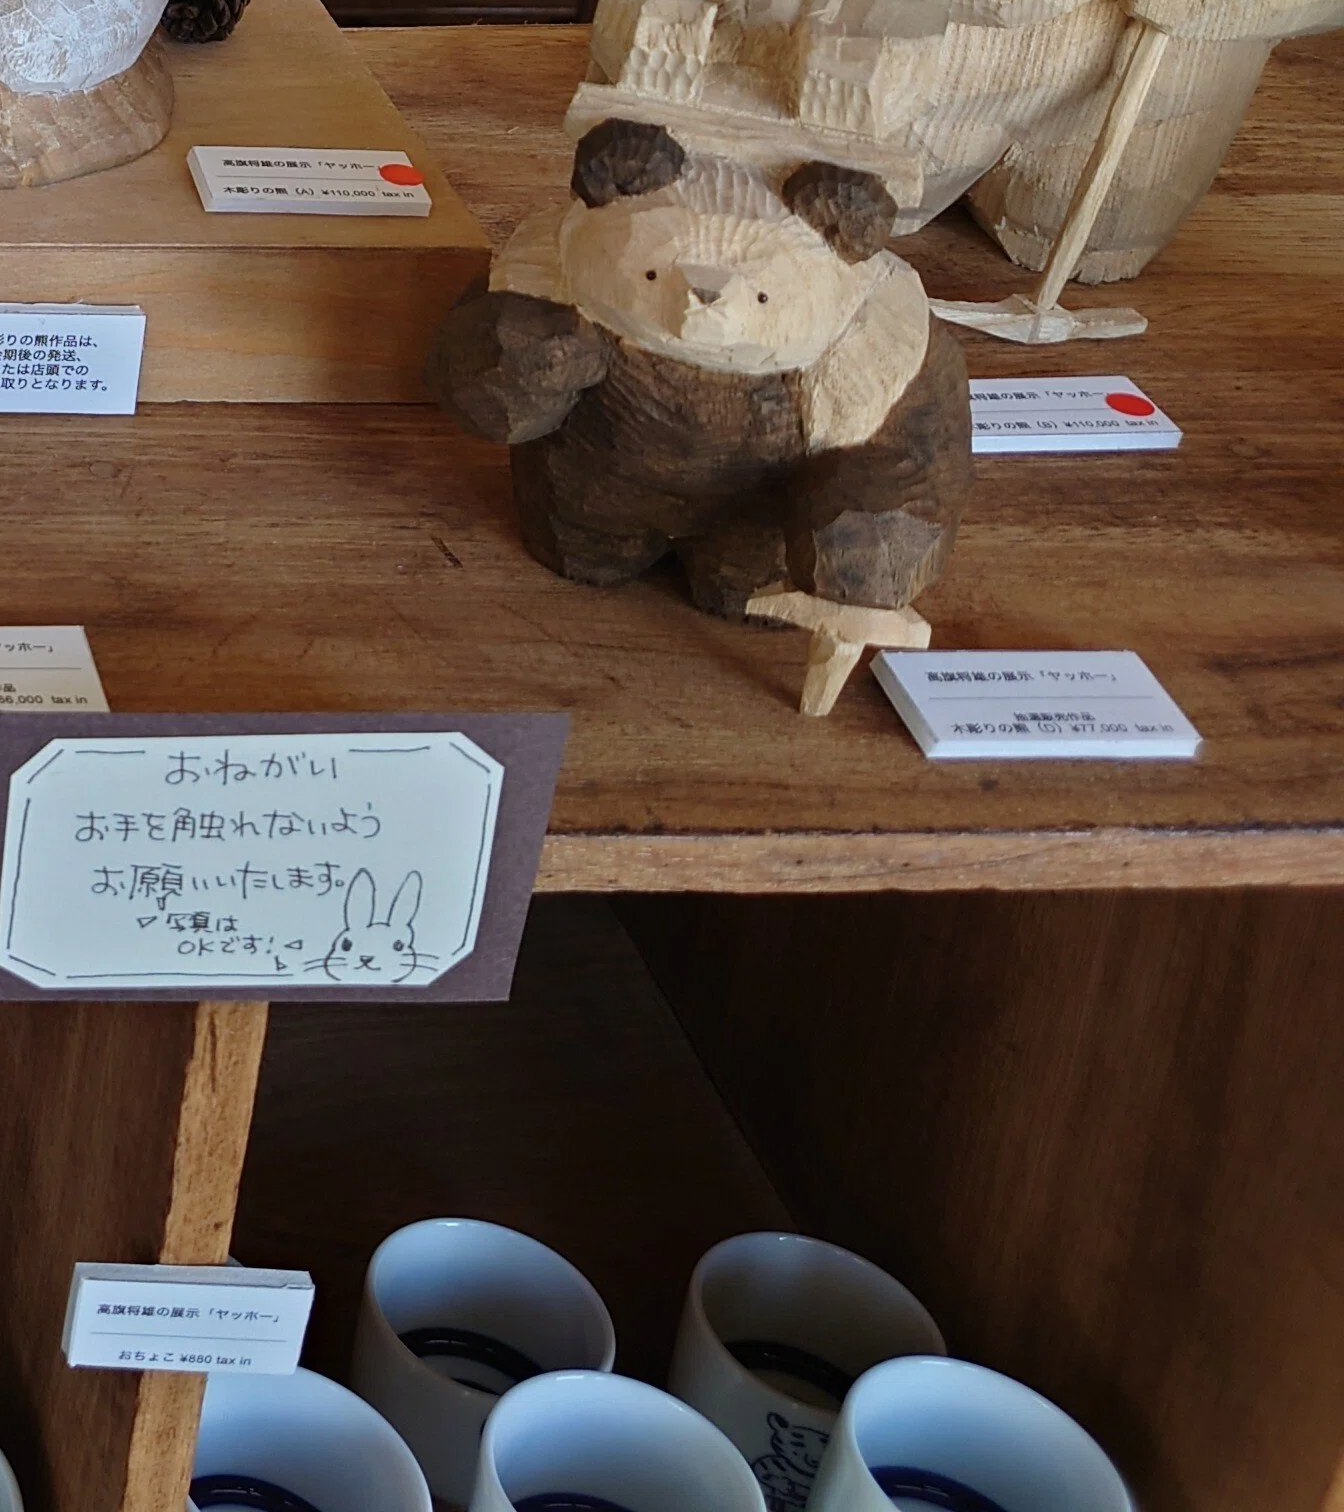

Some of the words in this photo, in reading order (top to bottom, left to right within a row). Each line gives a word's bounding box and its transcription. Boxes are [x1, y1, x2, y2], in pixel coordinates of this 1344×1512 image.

[51, 696, 71, 704] tax
[75, 696, 88, 704] in
[164, 750, 339, 786] おねがい
[74, 801, 383, 843] お手を触れないよう
[91, 862, 346, 901] お願いいたします。
[165, 910, 238, 936] 写真は
[96, 1303, 280, 1323] 高旗将雄の展示「ヤッホー」
[118, 1350, 175, 1362] おちょこ
[180, 1353, 213, 1364] ¥880
[216, 1355, 236, 1365] tax
[239, 1356, 252, 1366] in
